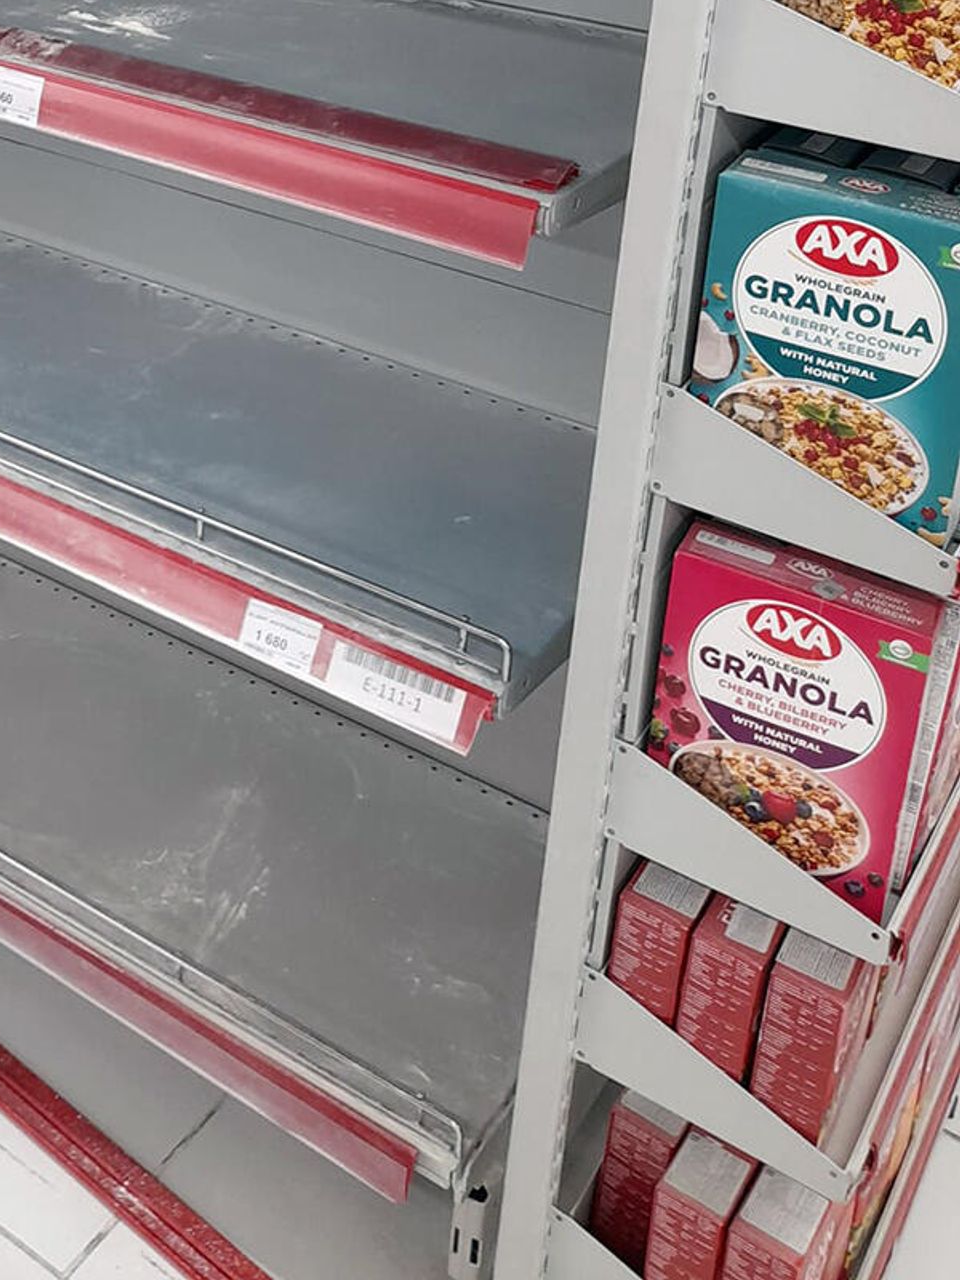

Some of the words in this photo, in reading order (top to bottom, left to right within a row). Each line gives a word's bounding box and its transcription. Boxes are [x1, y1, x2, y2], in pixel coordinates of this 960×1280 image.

[802, 224, 888, 272] AXA
[795, 273, 886, 304] WHOLEGRAIN
[744, 274, 934, 345] GRANOLA
[749, 305, 841, 339] CRANBERRY,
[844, 330, 922, 358] COCONUT
[781, 326, 792, 336] &
[795, 330, 833, 348] FLAX
[838, 341, 887, 362] SEEDS
[779, 347, 814, 363] WITH
[816, 354, 878, 382] NATURAL
[803, 364, 850, 385] HONEY
[794, 560, 829, 577] AXA
[752, 608, 832, 658] AXA
[699, 646, 874, 726] GRANOLA
[745, 649, 830, 685] WHOLEGRAIN
[362, 676, 422, 714] E-111-1
[718, 678, 775, 708] CHERRY,
[778, 700, 848, 730] BILBERRY
[731, 713, 765, 733] WITH
[765, 725, 824, 754] NATURAL
[734, 696, 744, 706] &
[747, 699, 830, 737] BLUEBERRY
[753, 733, 797, 755] HONEY
